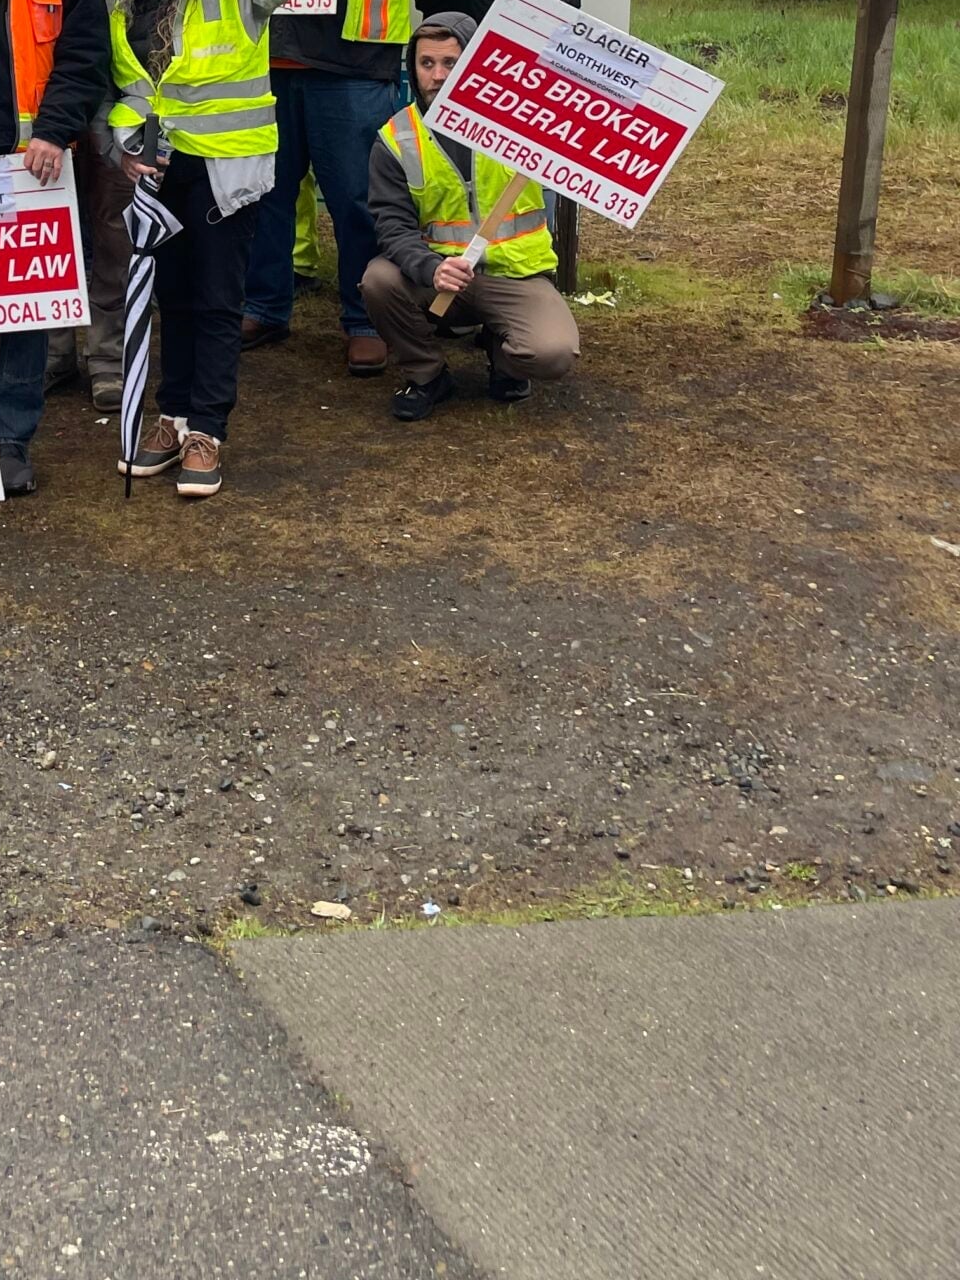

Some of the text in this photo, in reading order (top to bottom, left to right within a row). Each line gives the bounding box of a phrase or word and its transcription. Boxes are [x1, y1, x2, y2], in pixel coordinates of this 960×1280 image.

[555, 42, 639, 90] NORTHWEST
[572, 22, 650, 69] GLACIER
[483, 49, 669, 151] HAS BROKEN
[459, 73, 660, 180] FEDERAL LAW
[435, 105, 639, 220] TEAMSTERS LOCAL 313
[7, 253, 71, 282] LAW
[51, 298, 83, 320] 313
